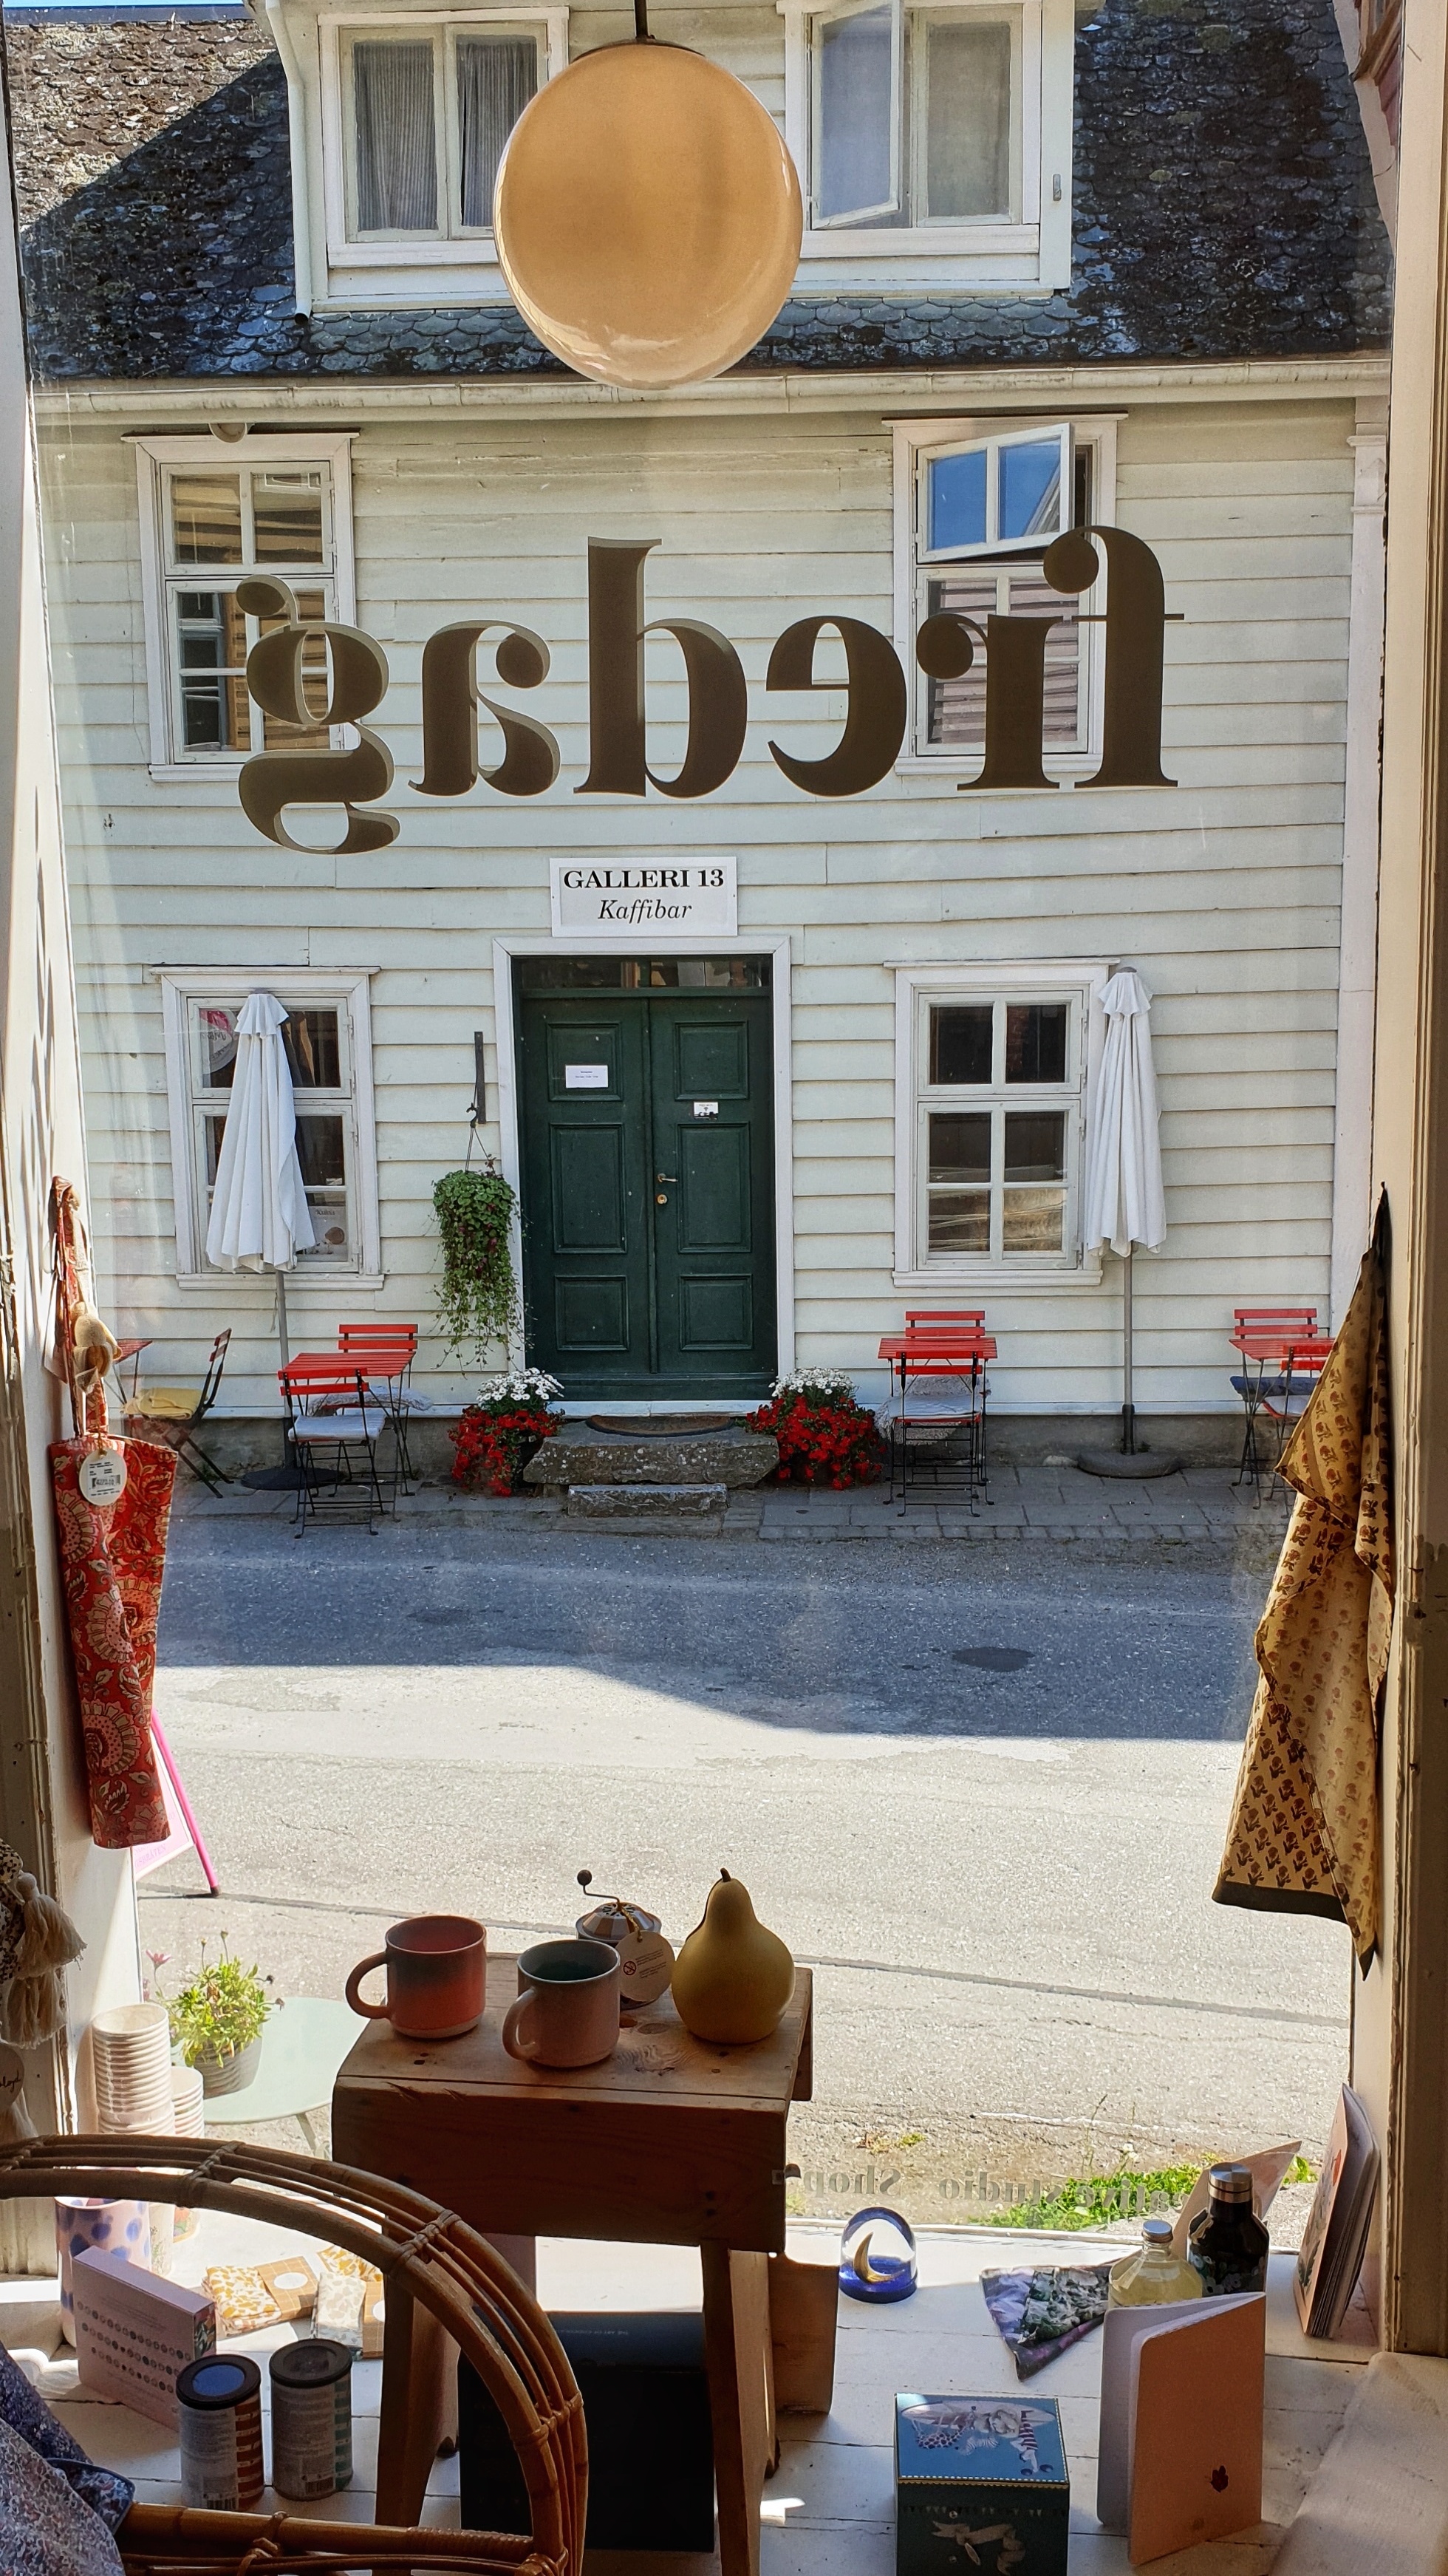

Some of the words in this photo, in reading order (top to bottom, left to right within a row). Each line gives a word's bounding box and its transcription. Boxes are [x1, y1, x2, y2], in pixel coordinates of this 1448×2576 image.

[564, 869, 690, 889] GALLERI
[697, 868, 725, 888] 13
[598, 899, 692, 924] Kaffibar
